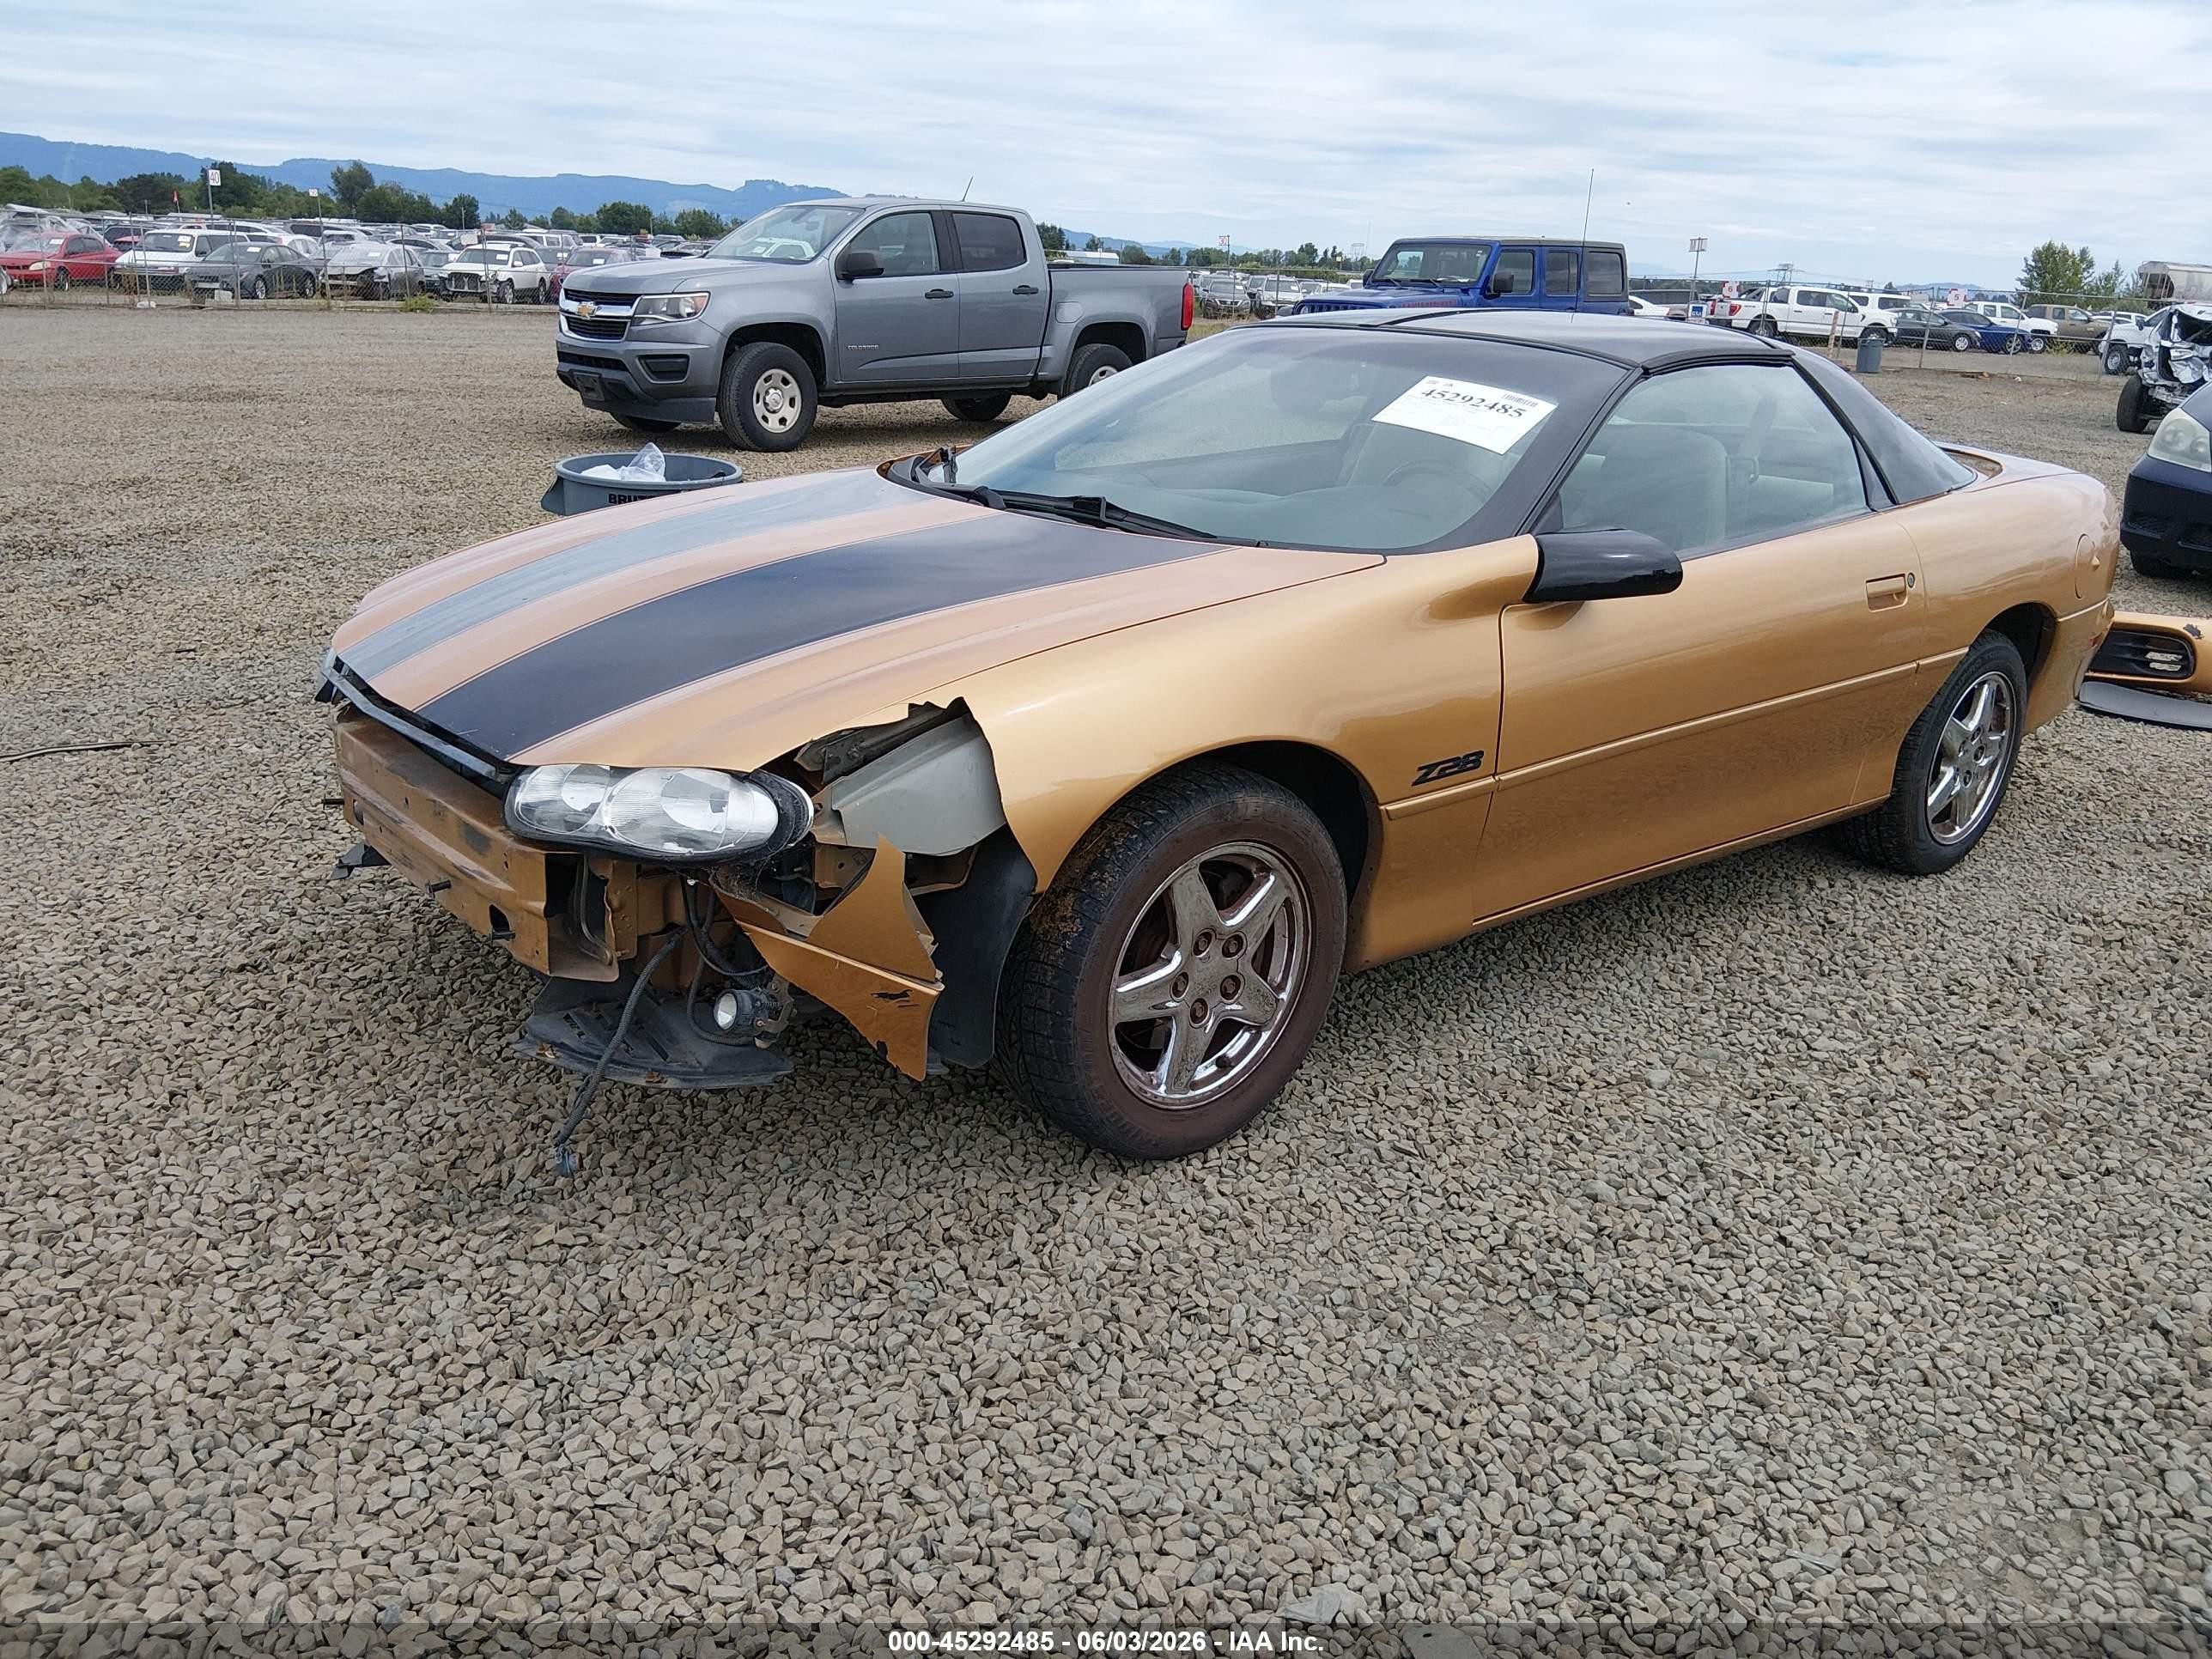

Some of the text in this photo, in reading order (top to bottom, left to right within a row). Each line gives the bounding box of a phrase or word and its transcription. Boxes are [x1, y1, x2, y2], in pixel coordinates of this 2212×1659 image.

[210, 171, 219, 184] 40
[1421, 388, 1527, 418] 45292485
[608, 494, 657, 505] BRU
[1411, 750, 1485, 787] Z28
